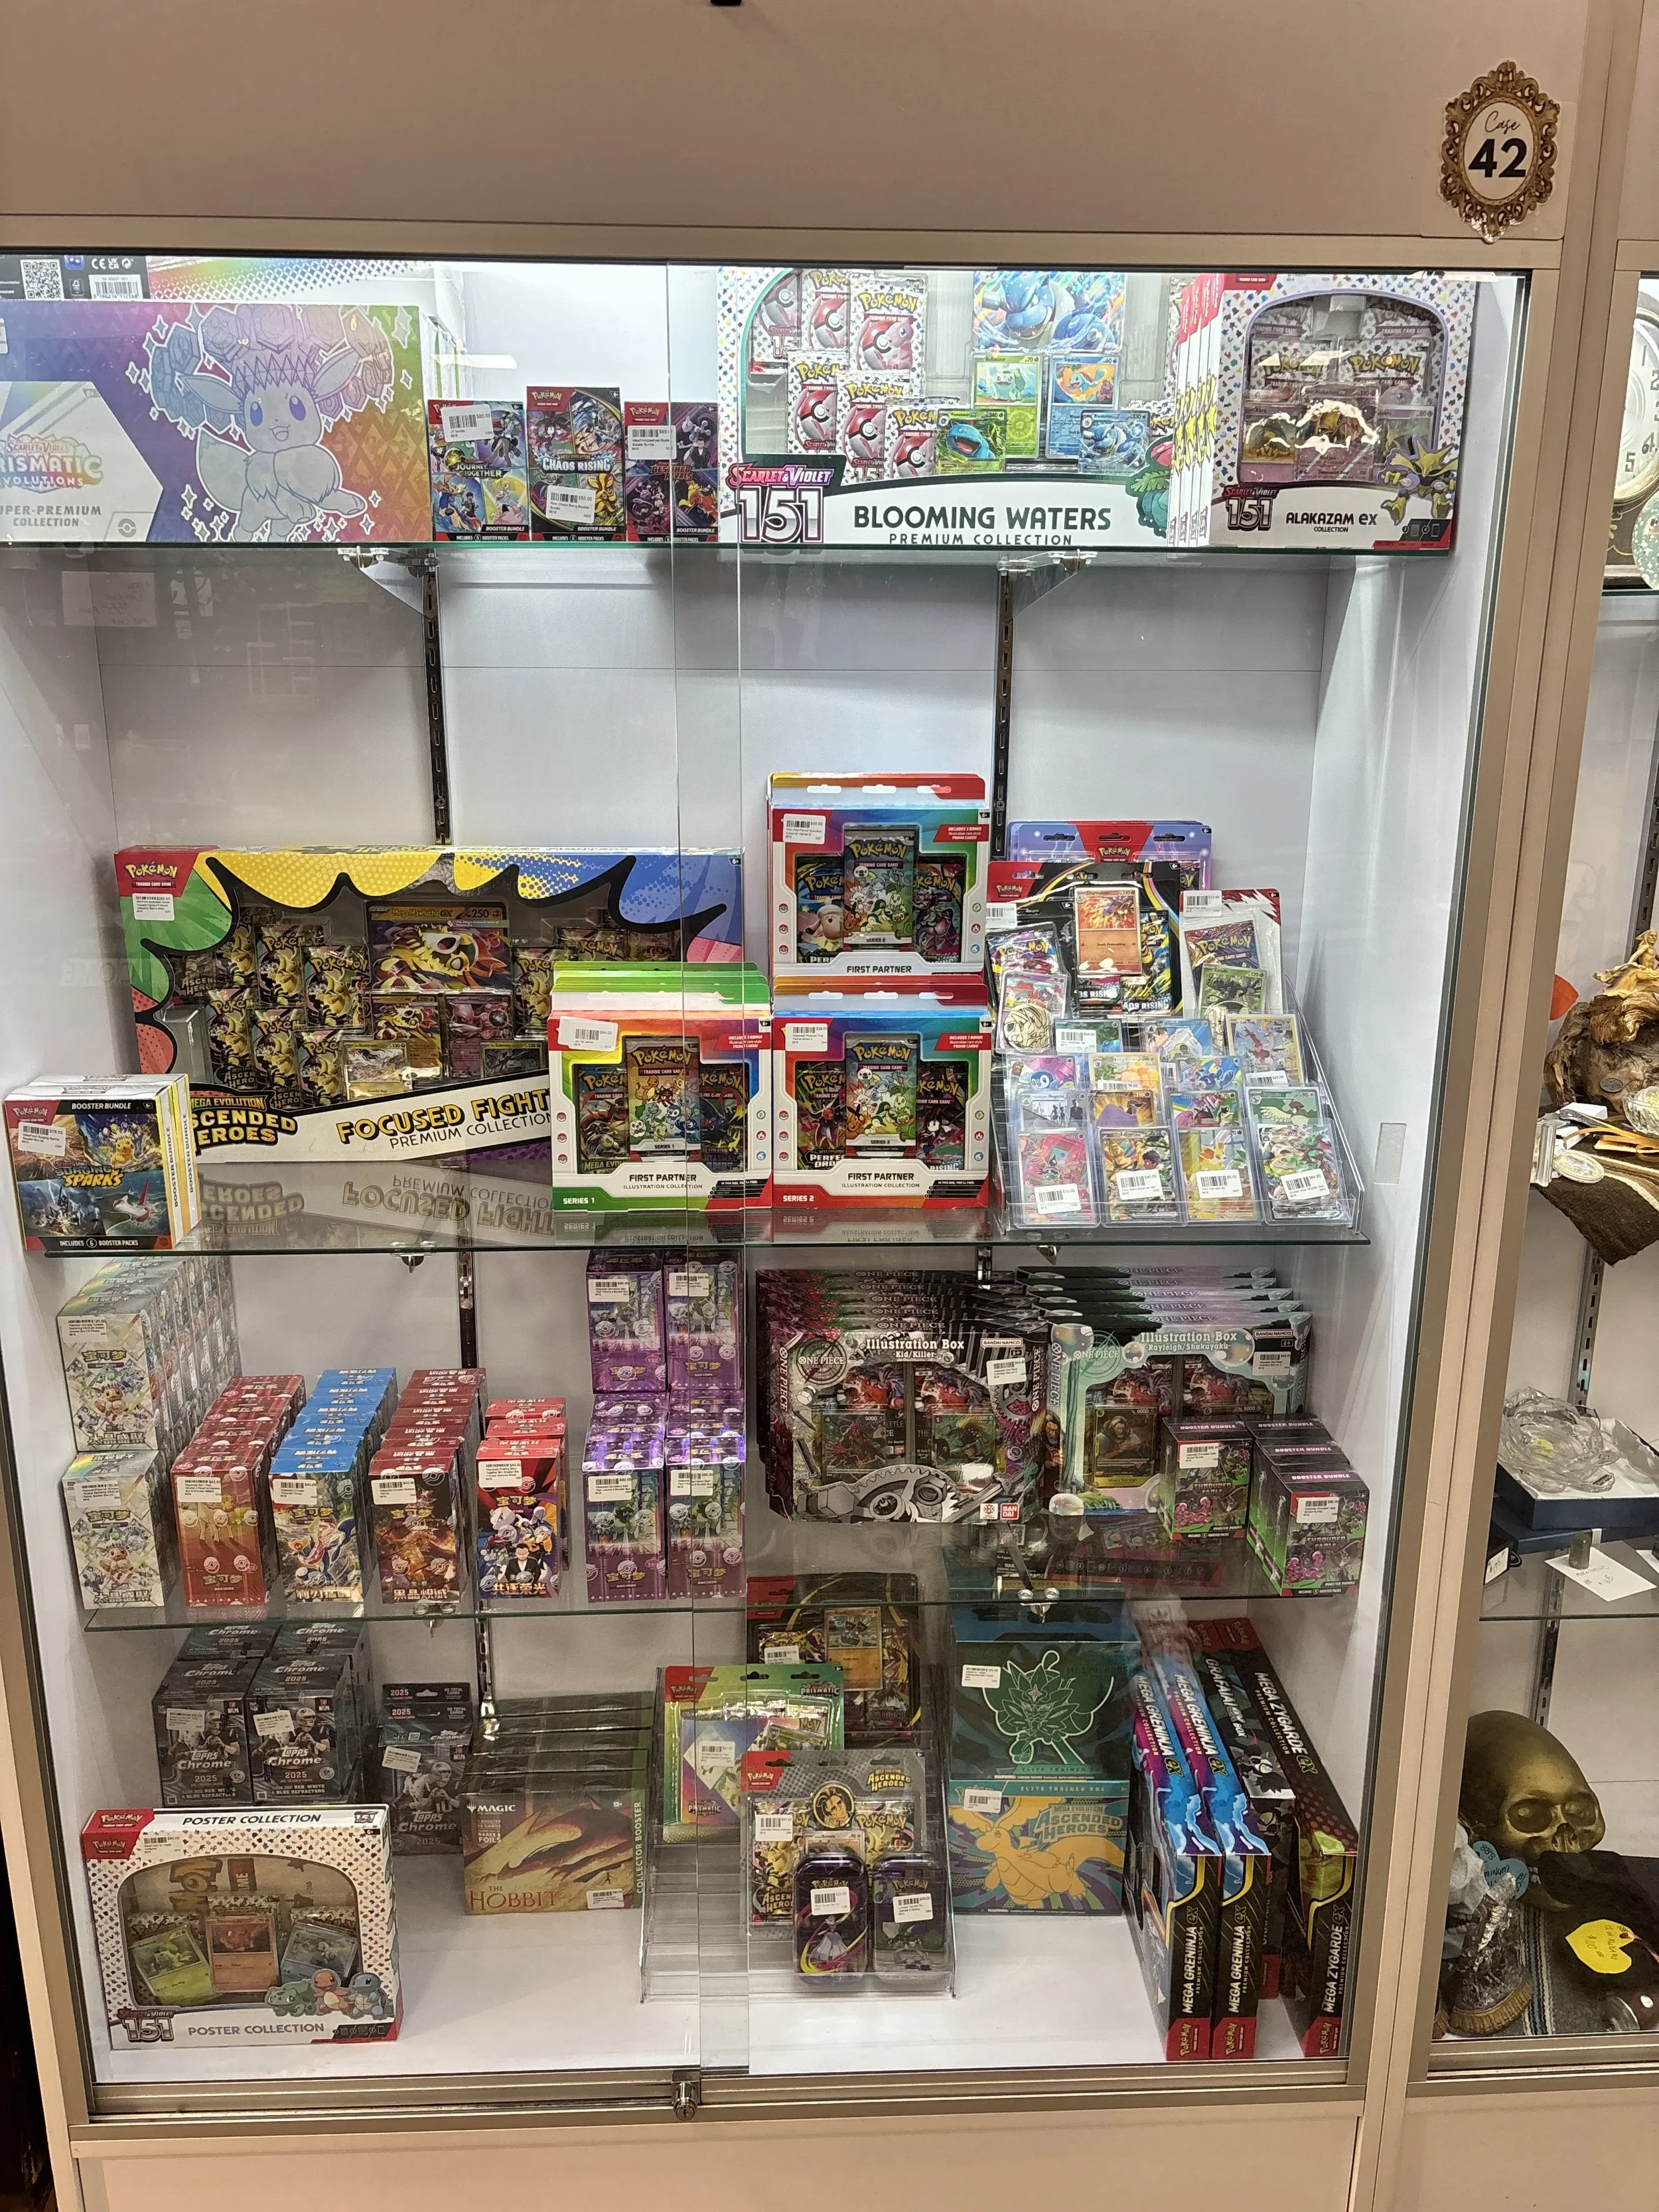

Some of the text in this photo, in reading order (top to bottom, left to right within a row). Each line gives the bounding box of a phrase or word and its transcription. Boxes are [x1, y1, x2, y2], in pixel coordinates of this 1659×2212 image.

[1484, 110, 1521, 134] Case
[1468, 137, 1527, 178] 42
[0, 455, 103, 479] RISMATIC
[543, 457, 611, 472] CHAOS RISING
[1625, 451, 1636, 473] 5
[3, 476, 84, 486] VOLUTIONS
[737, 486, 826, 545] 151
[854, 506, 1112, 531] BLOOMING WATERS
[1226, 497, 1274, 532] 151
[1285, 512, 1378, 526] ALAKAZAM ex
[13, 518, 79, 527] COLLECTION
[889, 533, 1072, 546] PREMIUM COLLECTION
[470, 909, 489, 919] 250
[214, 1096, 265, 1110] EVOLUTION
[192, 1110, 297, 1132] SCENDED
[337, 1088, 550, 1143] FOCUSED FIGHT
[196, 1126, 277, 1145] EROES
[390, 1111, 551, 1149] PREMIUM COLLECTION
[55, 1165, 113, 1177] SURGING
[63, 1171, 125, 1187] SPARKS
[865, 1338, 965, 1351] Illustration Box
[1141, 1331, 1238, 1343] Illustration Box
[1074, 1350, 1094, 1359] ONE
[1145, 1342, 1232, 1352] -Rayleigh/Shakuyaku-
[798, 1356, 845, 1365] ONE PIECE
[893, 1351, 938, 1359] -Kid/Killer-
[780, 1377, 788, 1412] PIECE
[1136, 1674, 1176, 1756] MEGA GRENINJA
[1174, 1673, 1219, 1755] MEGA GRENINJA
[1254, 1672, 1309, 1756] MEGA ZYGARDE
[192, 1749, 218, 1761] Topps
[282, 1745, 309, 1757] Topps
[178, 1759, 232, 1770] Chrome
[267, 1756, 323, 1767] Chrome
[867, 1773, 911, 1786] ASCENDED
[871, 1780, 904, 1792] HEROES
[182, 1813, 321, 1826] POSTER COLLECTION
[413, 1810, 443, 1822] Topps
[1037, 1810, 1121, 1830] ASCENDED
[399, 1822, 457, 1832] Chrome
[1043, 1825, 1107, 1840] HEROES
[634, 1801, 643, 1894] COLLECTOR BOOSTER
[469, 1889, 559, 1911] HOBBIT
[1182, 1926, 1197, 2014] MEGA GRENINJA
[1228, 1925, 1246, 2014] MEGA GRENINJA
[1323, 1923, 1344, 2014] MEGA ZYGARDE
[124, 2018, 175, 2042] 151
[188, 2023, 325, 2036] POSTER COLLECTION
